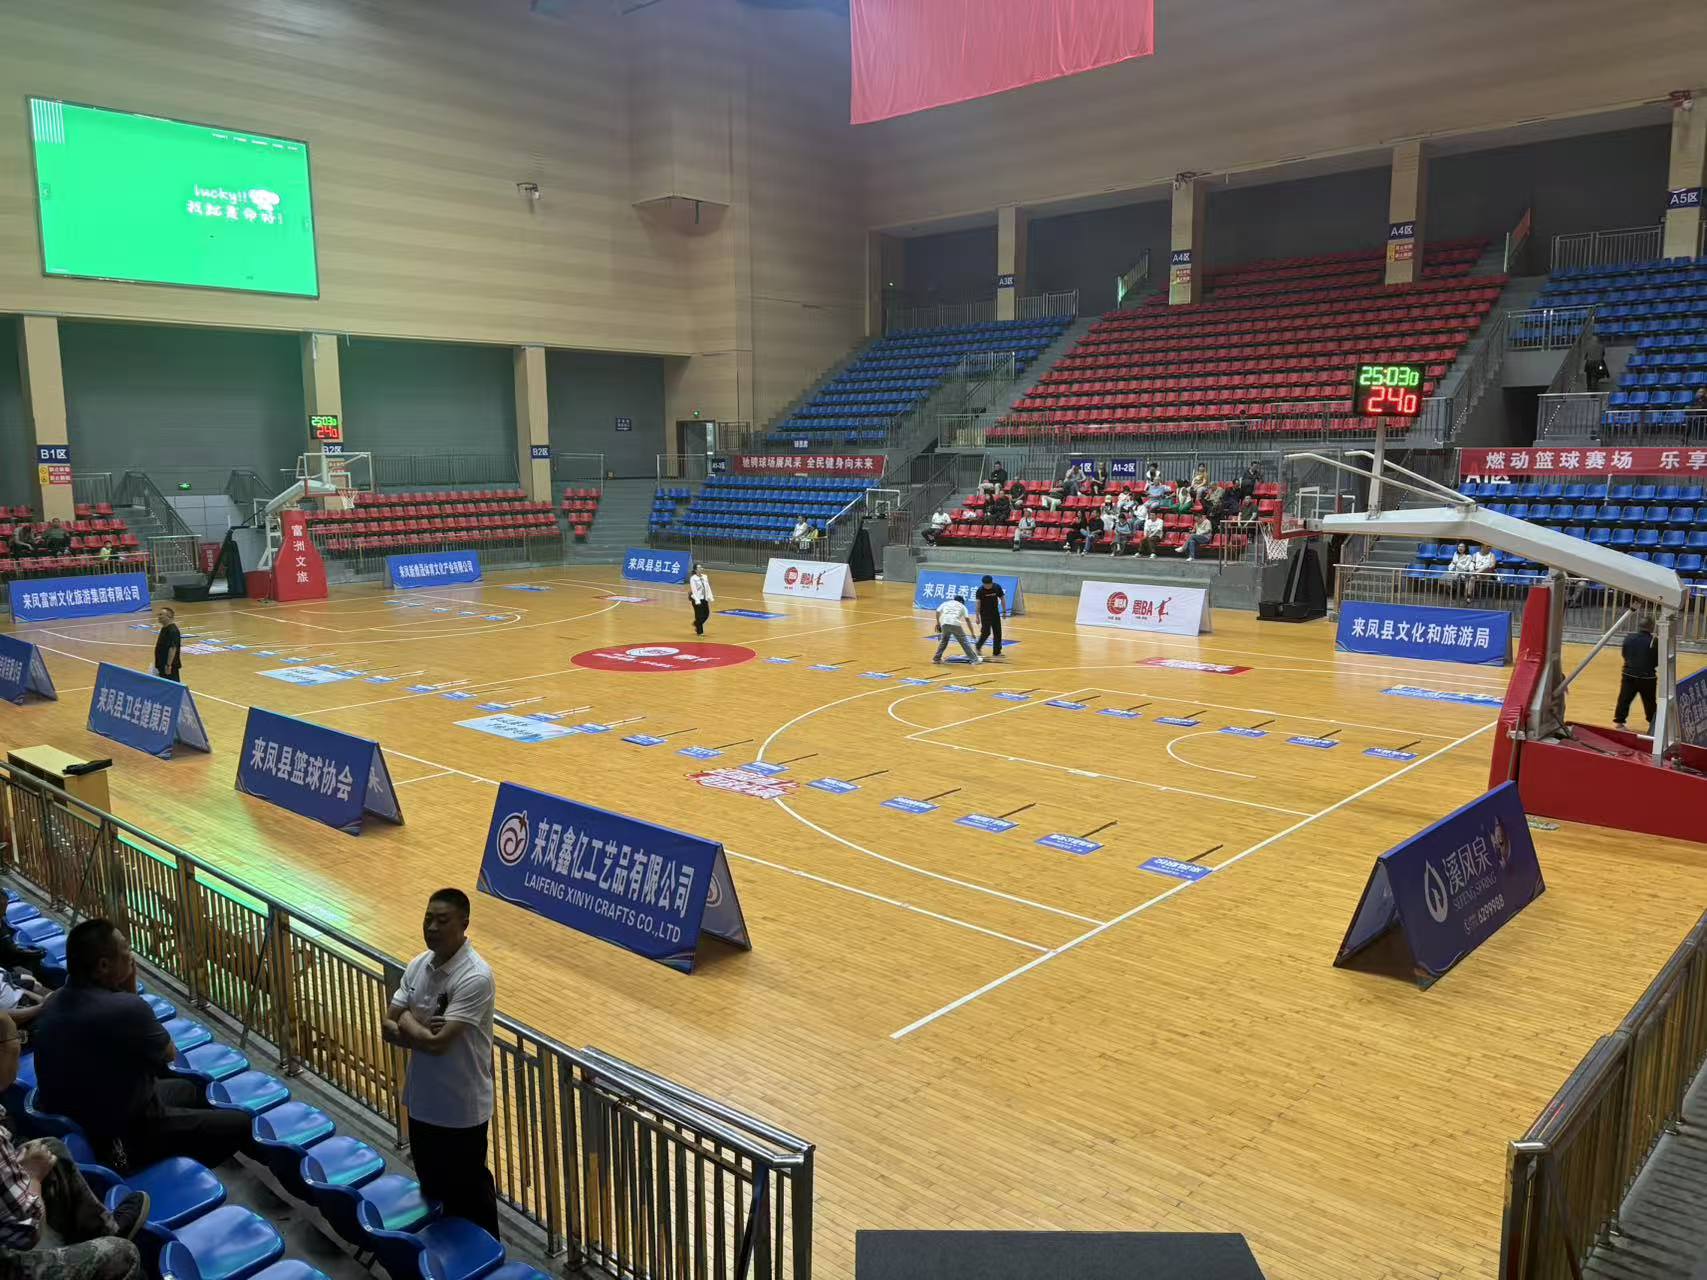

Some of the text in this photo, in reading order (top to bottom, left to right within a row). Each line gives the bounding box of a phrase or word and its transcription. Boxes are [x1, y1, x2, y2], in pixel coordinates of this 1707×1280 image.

[1670, 192, 1699, 205] A5区
[1391, 225, 1413, 237] A4区
[1172, 252, 1190, 262] A4区
[40, 448, 68, 459] B1区
[532, 447, 549, 456] B2区
[1485, 450, 1634, 470] 燃动篮球赛场
[806, 456, 874, 470] 全民健身向未来
[1112, 463, 1136, 473] A1-2区
[291, 525, 309, 583] 富洲文旅
[627, 556, 681, 575] 来凤县总工会
[22, 585, 141, 610] 来凤富洲文化旅游集团有限公司
[1351, 616, 1491, 649] 来凤县文化和旅游局
[97, 687, 172, 736] 来凤县卫生健康局
[250, 736, 353, 802] 来凤县篮球协会
[530, 817, 695, 919] 来凤鑫亿工艺品有限公司
[524, 871, 565, 900] LAIFENG
[565, 887, 595, 911] XINYI
[594, 897, 636, 927] CRAFTS
